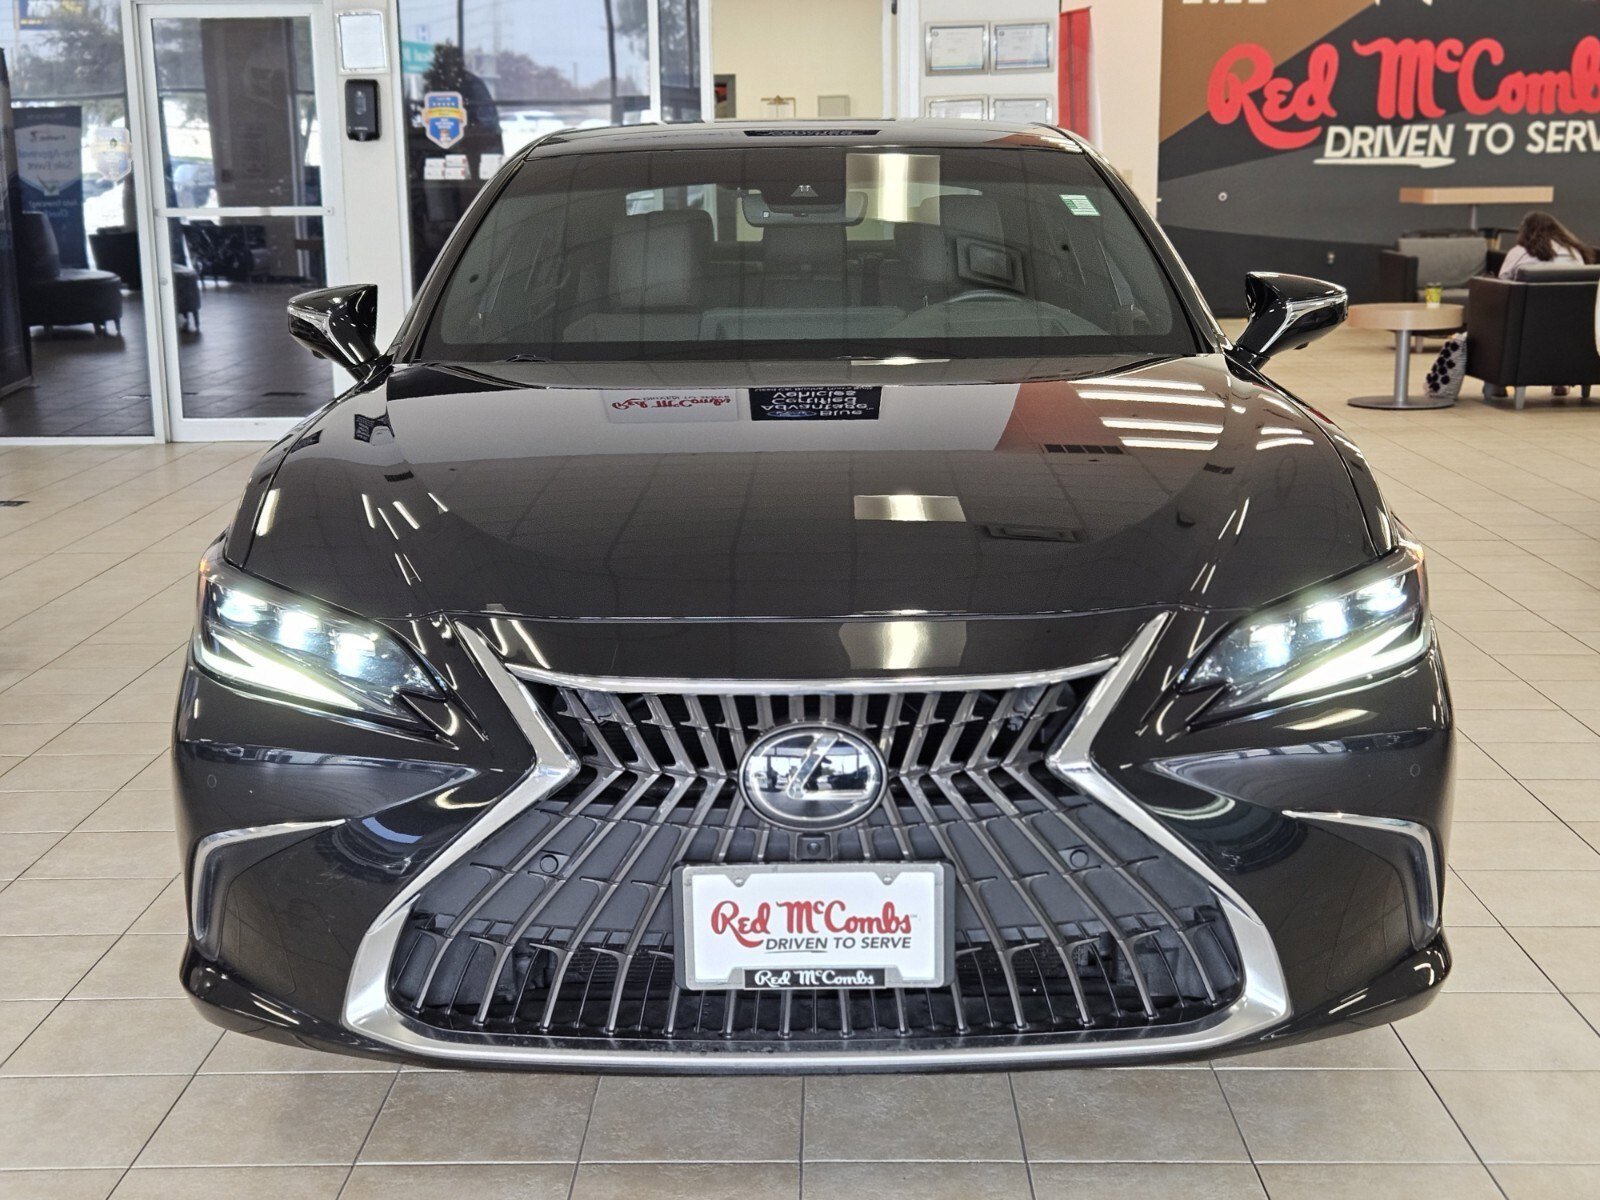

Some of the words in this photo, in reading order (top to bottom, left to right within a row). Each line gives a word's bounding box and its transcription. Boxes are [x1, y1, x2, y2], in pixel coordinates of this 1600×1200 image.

[1207, 43, 1338, 149] Red
[1324, 124, 1454, 158] DRIVEN
[1465, 123, 1514, 155] TO
[711, 900, 770, 948] Red
[776, 900, 911, 934] McCombs
[766, 937, 828, 950] DRIVEN
[833, 937, 856, 949] TO
[861, 936, 911, 949] SERVE
[754, 970, 790, 988] Red
[794, 969, 875, 986] McCombs
